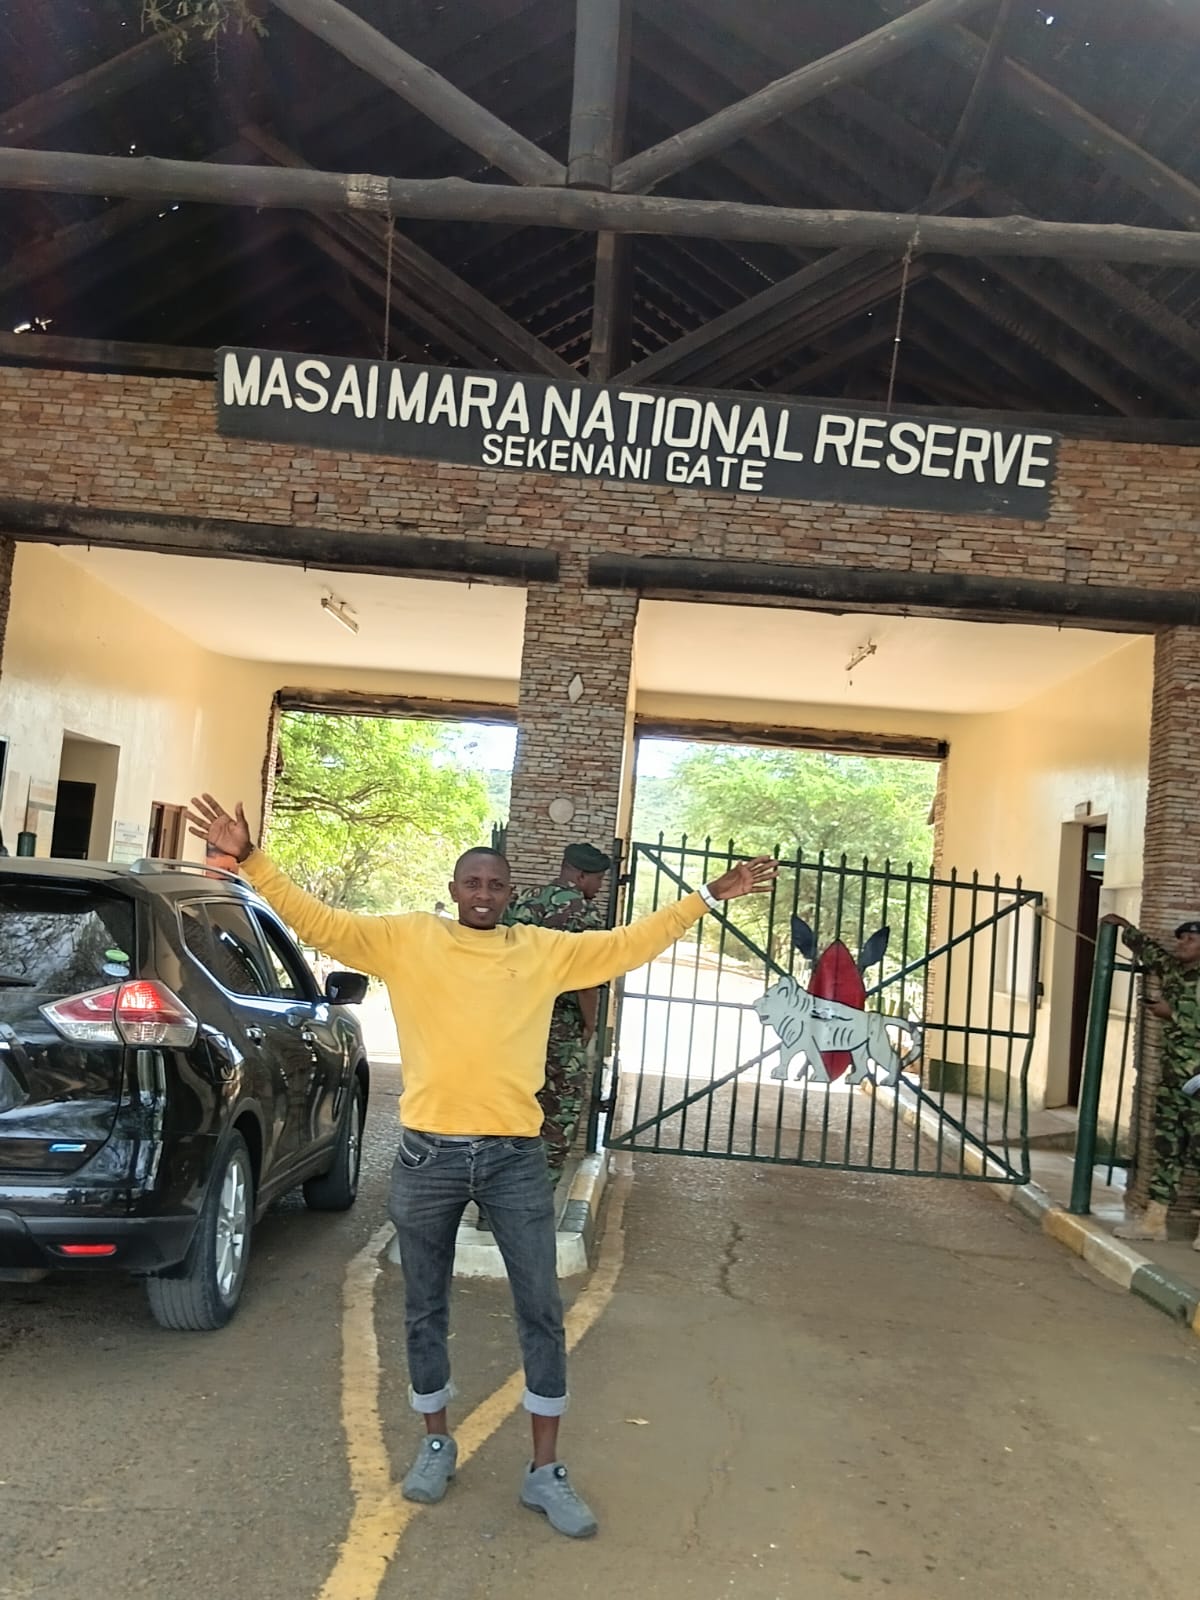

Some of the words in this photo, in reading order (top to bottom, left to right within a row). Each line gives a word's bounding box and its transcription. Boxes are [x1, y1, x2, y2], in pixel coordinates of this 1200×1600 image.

[223, 353, 379, 419] MASAI
[386, 368, 530, 434] MARA
[541, 386, 803, 461] NATIONAL
[813, 415, 1052, 488] RESERVE
[482, 434, 651, 480] SEKENANI
[665, 451, 767, 491] GATE
